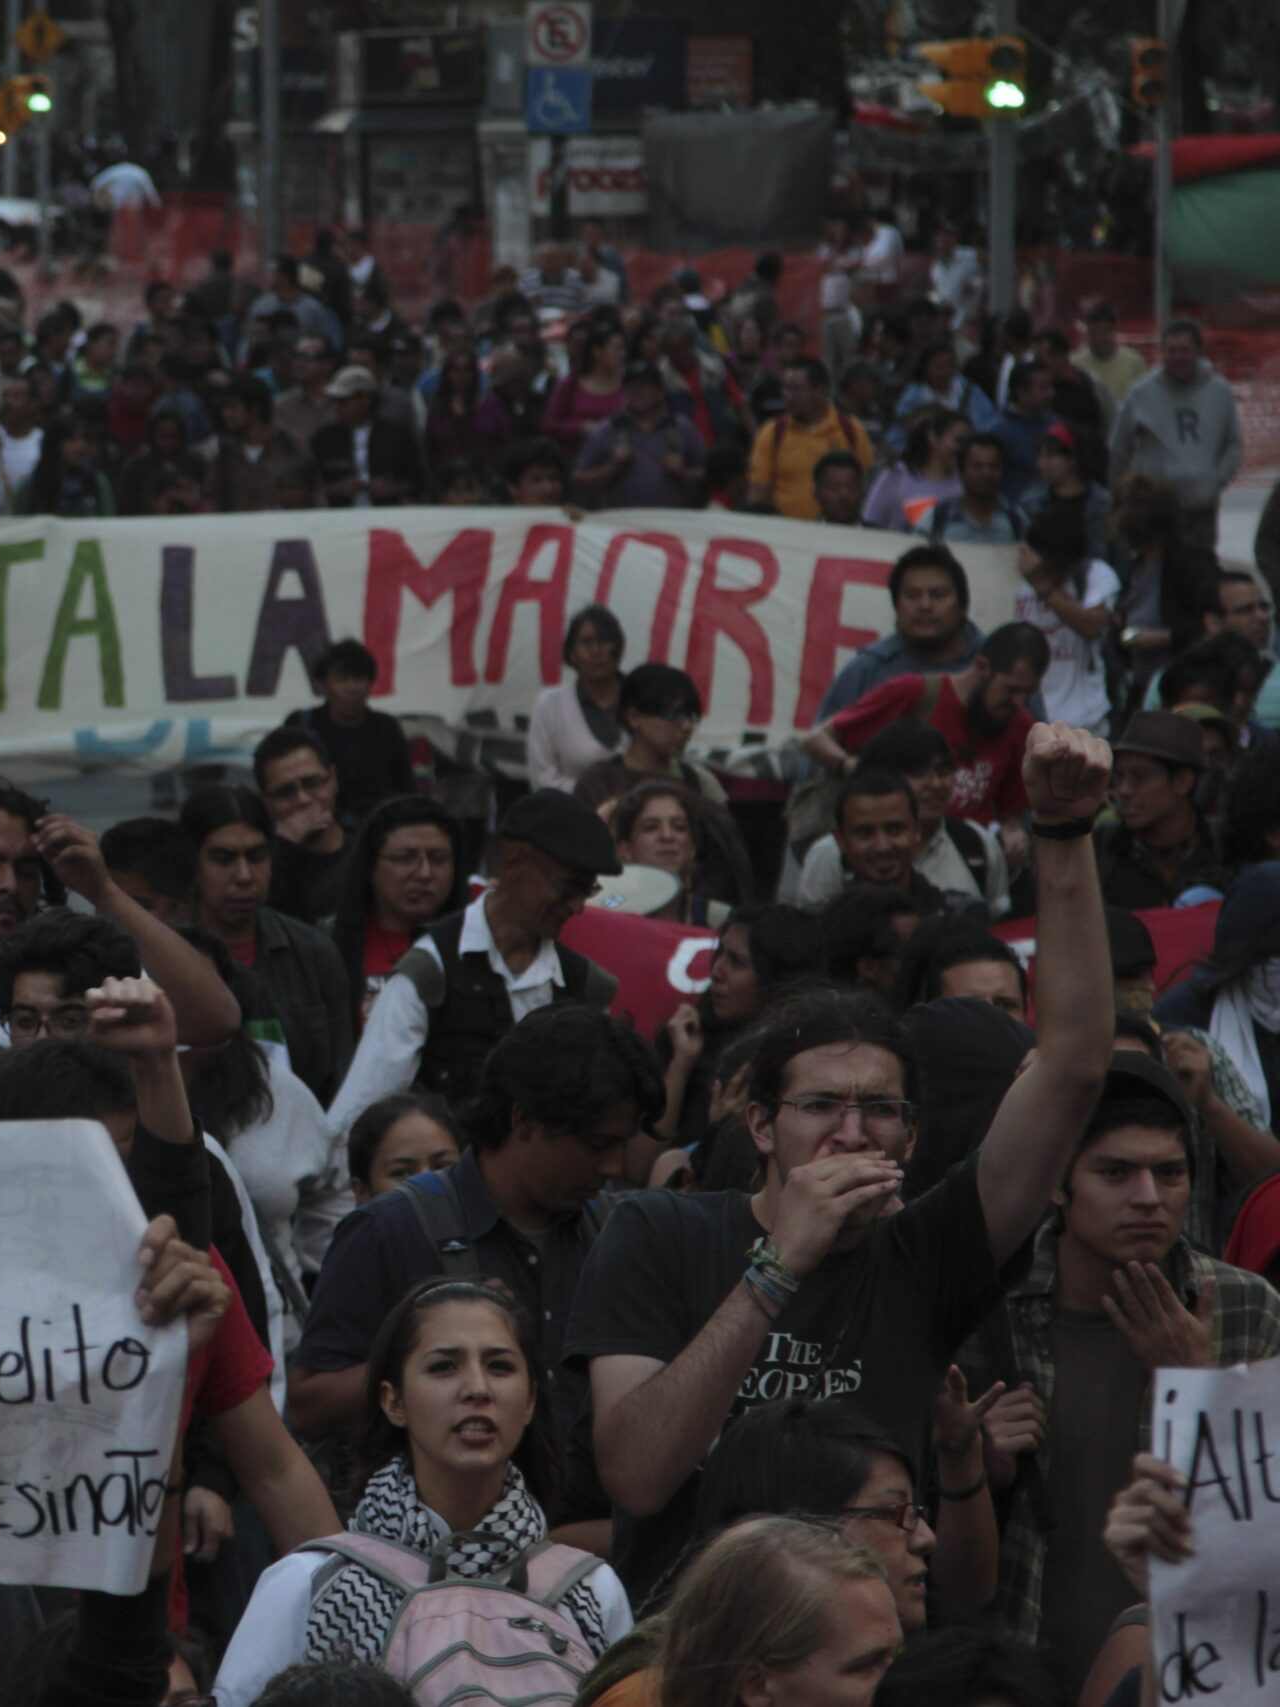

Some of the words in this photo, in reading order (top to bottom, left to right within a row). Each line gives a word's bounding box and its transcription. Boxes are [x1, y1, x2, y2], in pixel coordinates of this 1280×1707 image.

[1175, 407, 1200, 444] R
[159, 534, 332, 703] LA
[763, 1331, 822, 1366] THE
[736, 1358, 863, 1401] EOPLES
[1160, 1611, 1223, 1704] de
